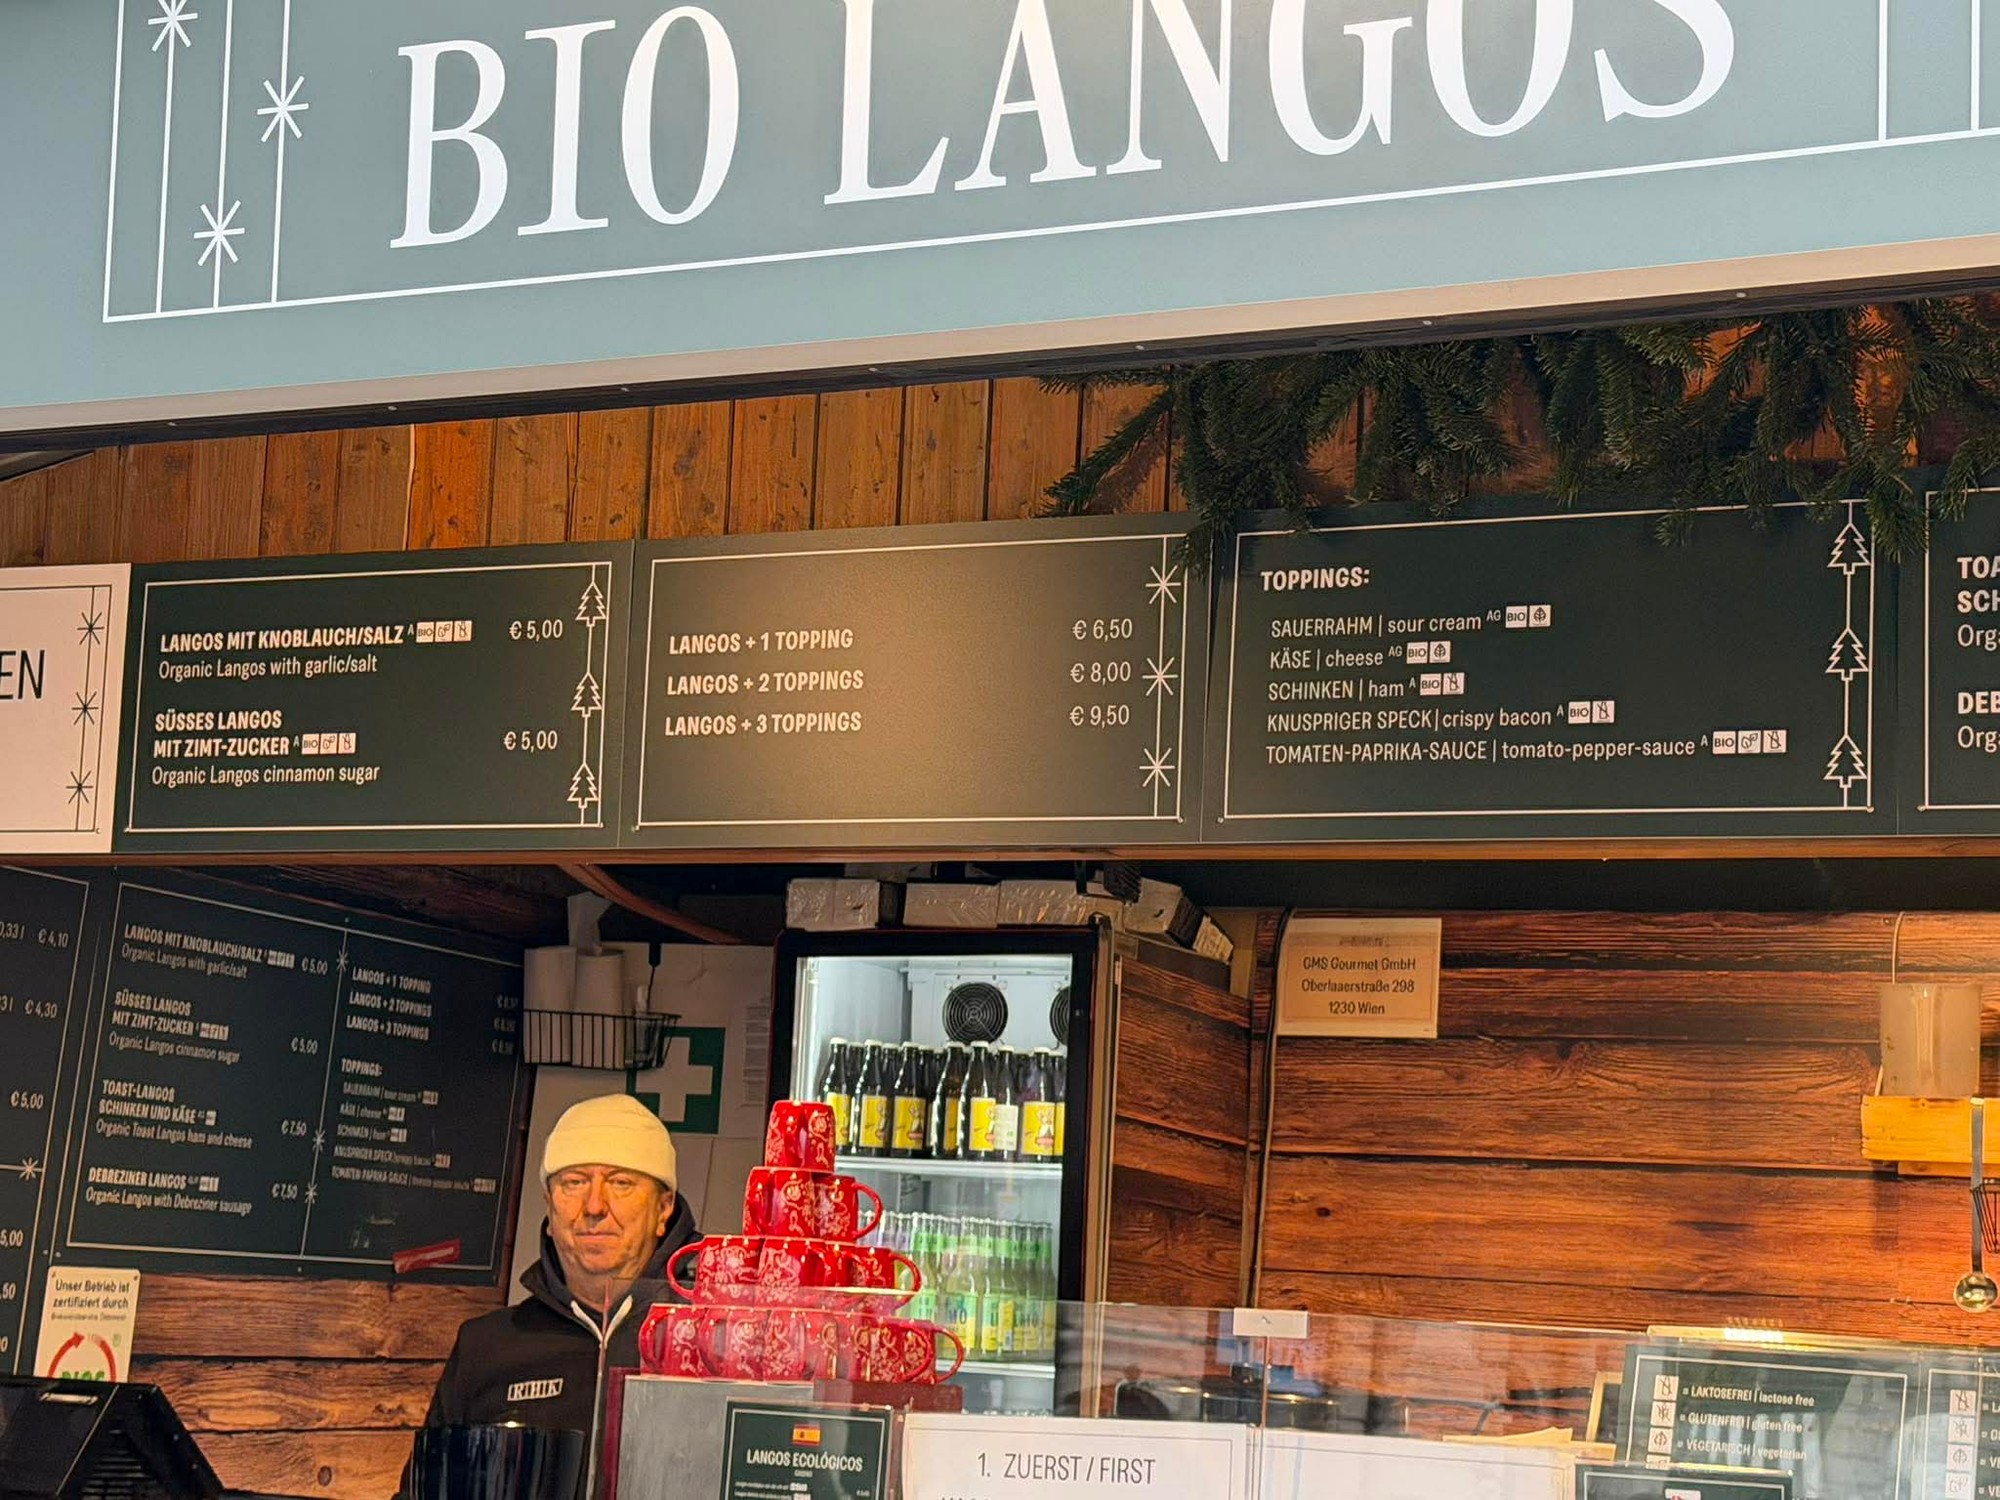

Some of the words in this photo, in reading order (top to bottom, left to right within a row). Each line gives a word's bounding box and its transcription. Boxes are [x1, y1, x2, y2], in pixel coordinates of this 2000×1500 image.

[390, 5, 739, 249] BIO
[824, 0, 1735, 206] LANGOS
[1260, 566, 1370, 592] TOPPINGS:
[509, 621, 522, 640] €
[526, 619, 563, 641] 5,00
[1072, 620, 1087, 640] €
[1093, 618, 1133, 642] 6,50
[1271, 616, 1372, 638] SAUERRAHM
[1387, 617, 1423, 633] sour
[1429, 615, 1481, 632] cream
[1507, 612, 1526, 622] BIO
[160, 632, 224, 652] LANGOS
[227, 631, 256, 650] MIT
[258, 625, 404, 649] KNOBLAUCH/SALZ
[669, 633, 740, 654] LANGOS
[745, 637, 756, 649] +
[760, 632, 769, 651] 1
[775, 628, 853, 650] TOPPING
[159, 660, 213, 682] Organic
[216, 658, 266, 680] Langos
[270, 656, 300, 676] with
[304, 653, 378, 678] garlic/salt
[1270, 648, 1311, 670] KÄSE
[1325, 650, 1383, 667] cheese
[1408, 647, 1426, 658] BIO
[667, 674, 739, 695] LANGOS
[744, 678, 753, 690] +
[758, 674, 770, 692] 2
[774, 670, 864, 691] TOPPINGS
[1070, 663, 1085, 683] €
[1090, 661, 1131, 686] 8,00
[1268, 679, 1353, 701] SCHINKEN
[1368, 680, 1404, 698] ham
[1421, 679, 1440, 689] BIO
[155, 709, 214, 732] SÜSSES
[218, 710, 282, 730] LANGOS
[664, 715, 737, 736] LANGOS
[741, 719, 751, 730] +
[756, 714, 768, 734] 3
[772, 711, 862, 733] TOPPINGS
[1069, 706, 1084, 726] €
[1090, 704, 1130, 729] 9,50
[1267, 710, 1371, 733] KNUSPRIGER
[1377, 709, 1432, 730] SPECK
[1442, 709, 1494, 731] crispy
[1500, 707, 1551, 727] bacon
[1570, 707, 1589, 718] BIO
[153, 740, 182, 759] MIT
[184, 737, 290, 758] ZIMT-ZUCKER
[503, 731, 516, 750] €
[521, 731, 558, 753] 5,00
[1266, 741, 1487, 764] TOMATEN-PAPRIKA-SAUCE
[1501, 740, 1695, 762] tomato-pepper-sauce
[1714, 737, 1734, 748] BIO
[152, 766, 206, 788] Organic
[210, 765, 259, 787] Langos
[263, 764, 334, 782] cinnamon
[339, 766, 380, 785] sugar
[124, 923, 163, 944] LANGOS
[164, 931, 182, 948] MIT
[121, 943, 155, 963] Organic
[157, 949, 187, 969] Langos
[187, 956, 206, 971] with
[1331, 957, 1378, 970] Gourmet
[1381, 957, 1416, 970] GmbH
[352, 966, 385, 985] LANGOS
[1392, 980, 1415, 993] 298
[115, 988, 151, 1010] SÜSSES
[153, 997, 192, 1017] LANGOS
[349, 991, 382, 1009] LANGOS
[1328, 1001, 1355, 1014] 1230
[1357, 1001, 1385, 1014] Wien
[111, 1010, 132, 1027] MIT
[346, 1015, 379, 1032] LANGOS
[109, 1030, 142, 1051] Organic
[144, 1036, 174, 1056] Langos
[102, 1079, 175, 1103] TOAST-LANGOS
[99, 1099, 149, 1119] SCHINKEN
[150, 1105, 170, 1121] UND
[171, 1105, 197, 1124] KÄSE
[96, 1118, 130, 1137] Organic
[156, 1124, 186, 1144] Langos
[88, 1166, 147, 1187] DEBREZINER
[148, 1173, 187, 1190] LANGOS
[85, 1186, 120, 1205] Organic
[121, 1189, 151, 1209] Langos
[55, 1279, 82, 1291] Unser
[84, 1280, 116, 1292] Betrieb
[119, 1282, 130, 1293] ist
[53, 1296, 100, 1308] zertifiziert
[101, 1298, 128, 1309] durch
[1691, 1385, 1752, 1401] LAKTOSEFREI
[1688, 1412, 1744, 1429] GLUTENFREI
[746, 1449, 791, 1467] LANGOS
[792, 1451, 863, 1472] ECOLÓGICOS
[977, 1452, 991, 1478] 1.
[1004, 1453, 1083, 1482] ZUERST
[1100, 1457, 1156, 1485] FIRST
